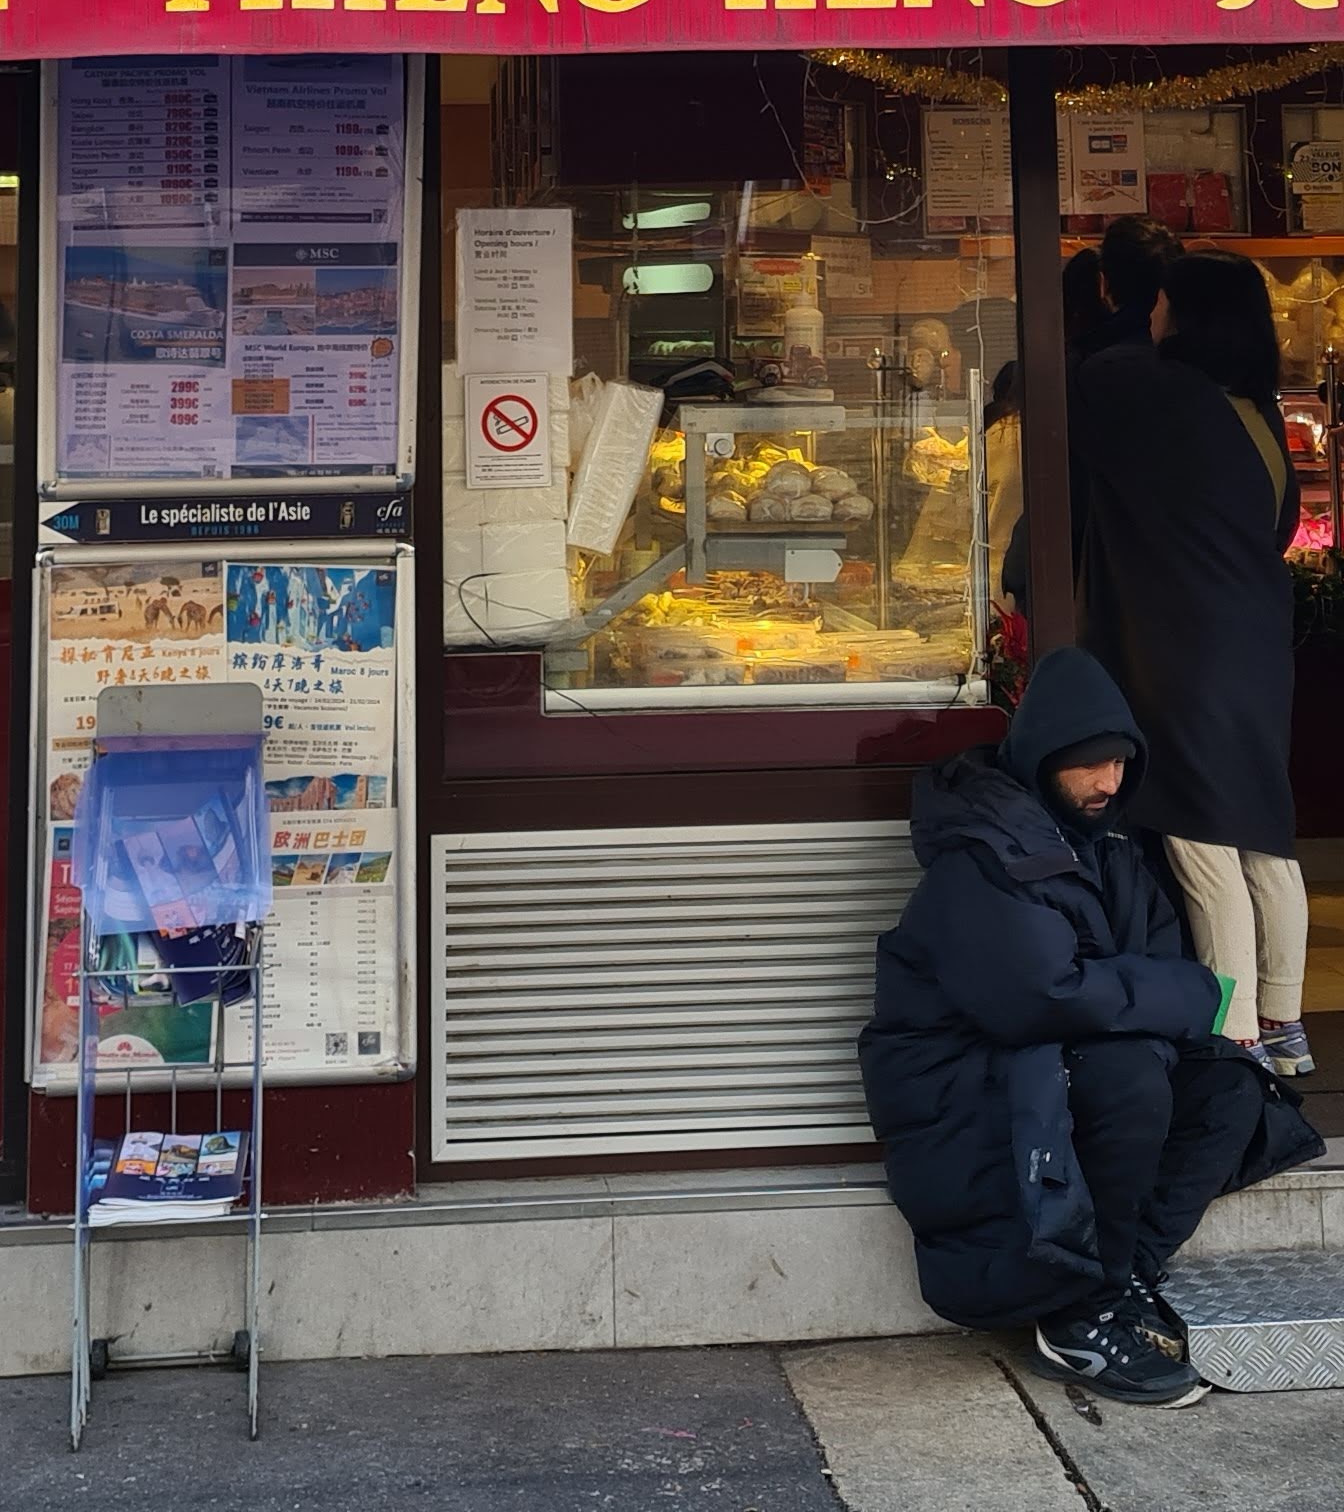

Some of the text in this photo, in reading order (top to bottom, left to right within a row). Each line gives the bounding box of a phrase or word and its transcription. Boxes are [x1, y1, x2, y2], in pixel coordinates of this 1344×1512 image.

[246, 86, 387, 95] Vietnam Airlines Promo Vol
[1311, 161, 1342, 172] BON
[474, 240, 509, 248] Opening
[309, 248, 340, 259] MSC
[130, 329, 224, 339] COSTA SMERALDA
[170, 398, 199, 409] 399€
[170, 414, 199, 425] 499€
[141, 501, 311, 528] Le spécialiste de l'Asie
[191, 525, 230, 536] DEPUIS
[330, 666, 389, 678] Maroc 8 jours
[272, 829, 368, 850] 欧洲巴士团
